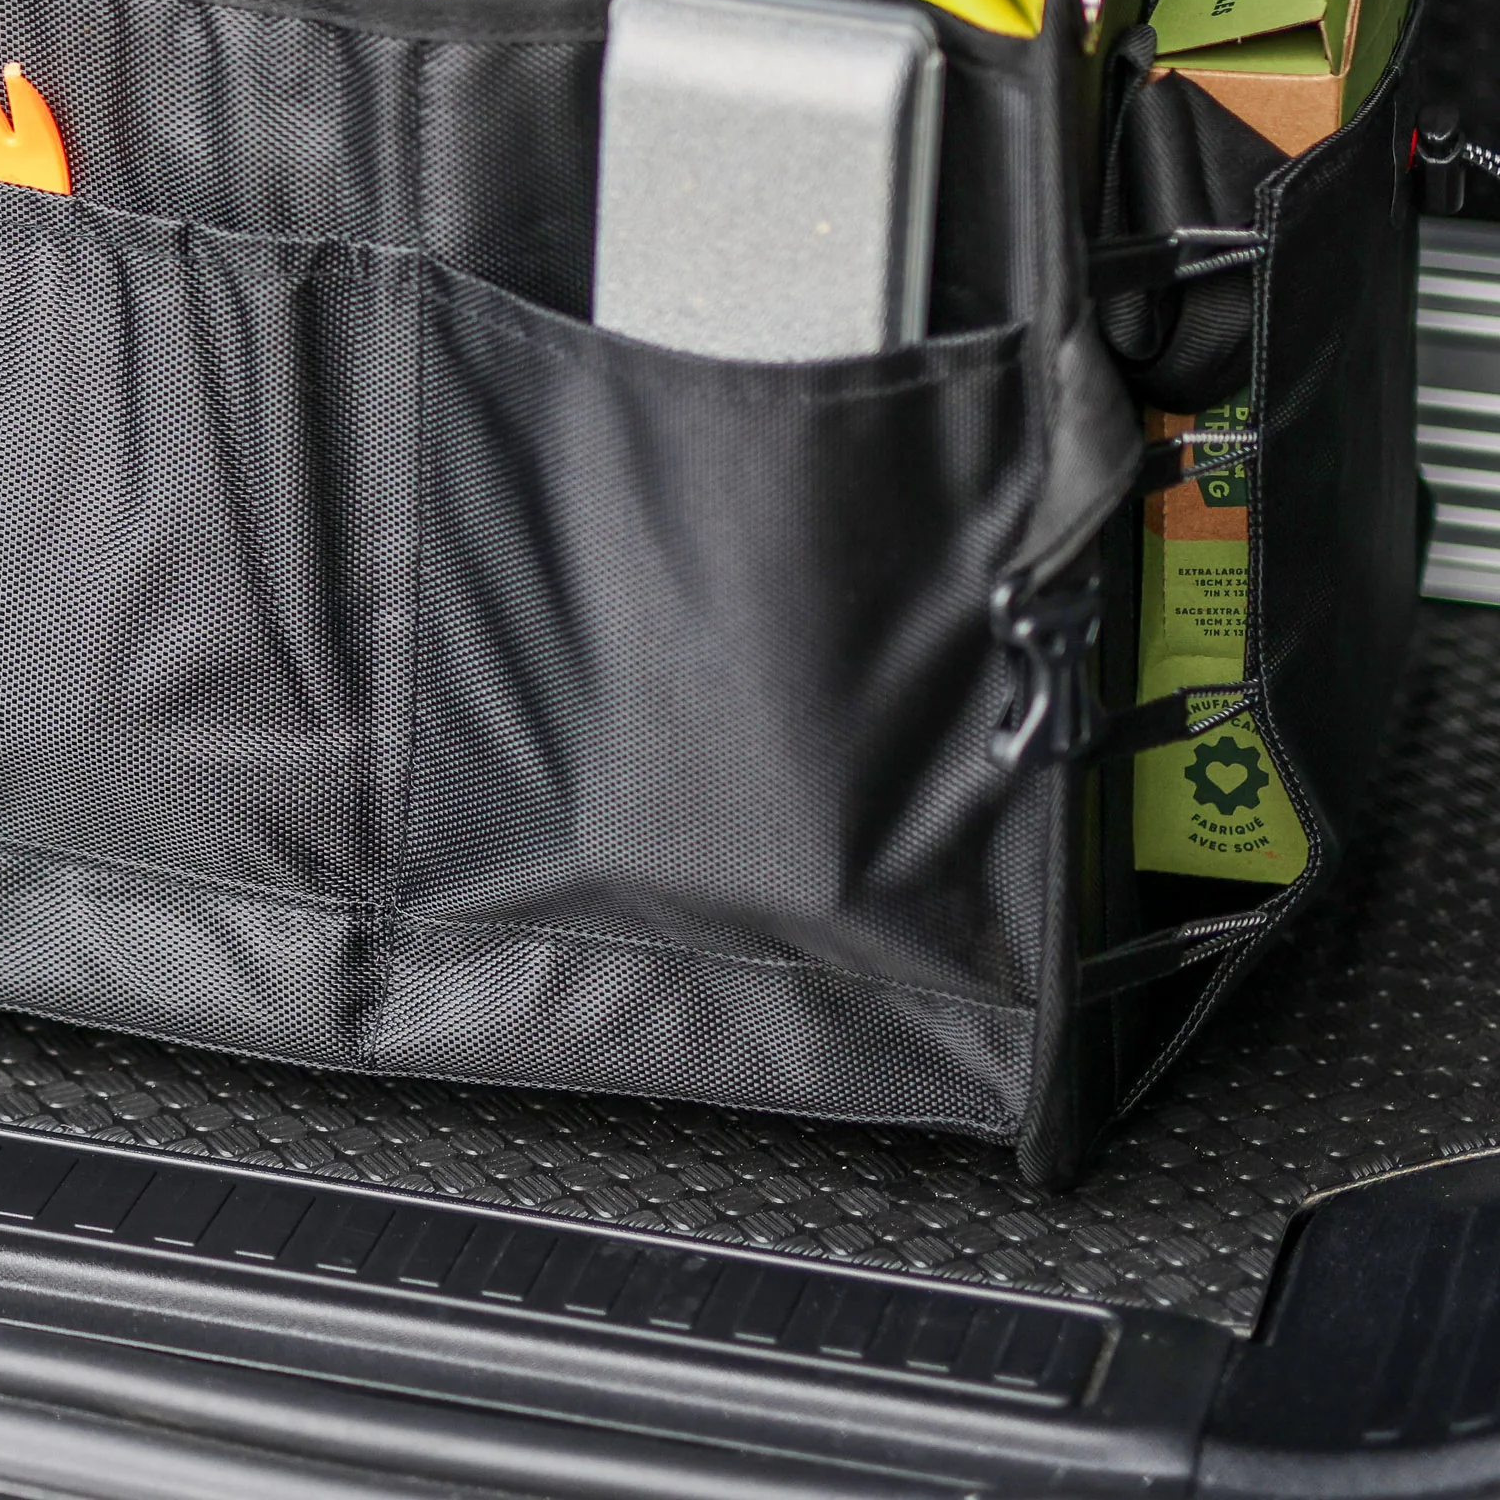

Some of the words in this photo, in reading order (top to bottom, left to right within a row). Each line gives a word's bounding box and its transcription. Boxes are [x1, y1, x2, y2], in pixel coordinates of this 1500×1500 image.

[1178, 568, 1212, 576] EXTRA
[1195, 579, 1223, 587] 18CM
[1226, 579, 1233, 587] X
[1175, 607, 1203, 615] SACS
[1206, 607, 1240, 615] EXTRA
[1195, 618, 1222, 626] 18CM
[1226, 618, 1232, 626] X
[1190, 813, 1265, 835] FABRIQUÉ
[1187, 832, 1228, 853] AVEC
[1234, 836, 1270, 853] SOIN
